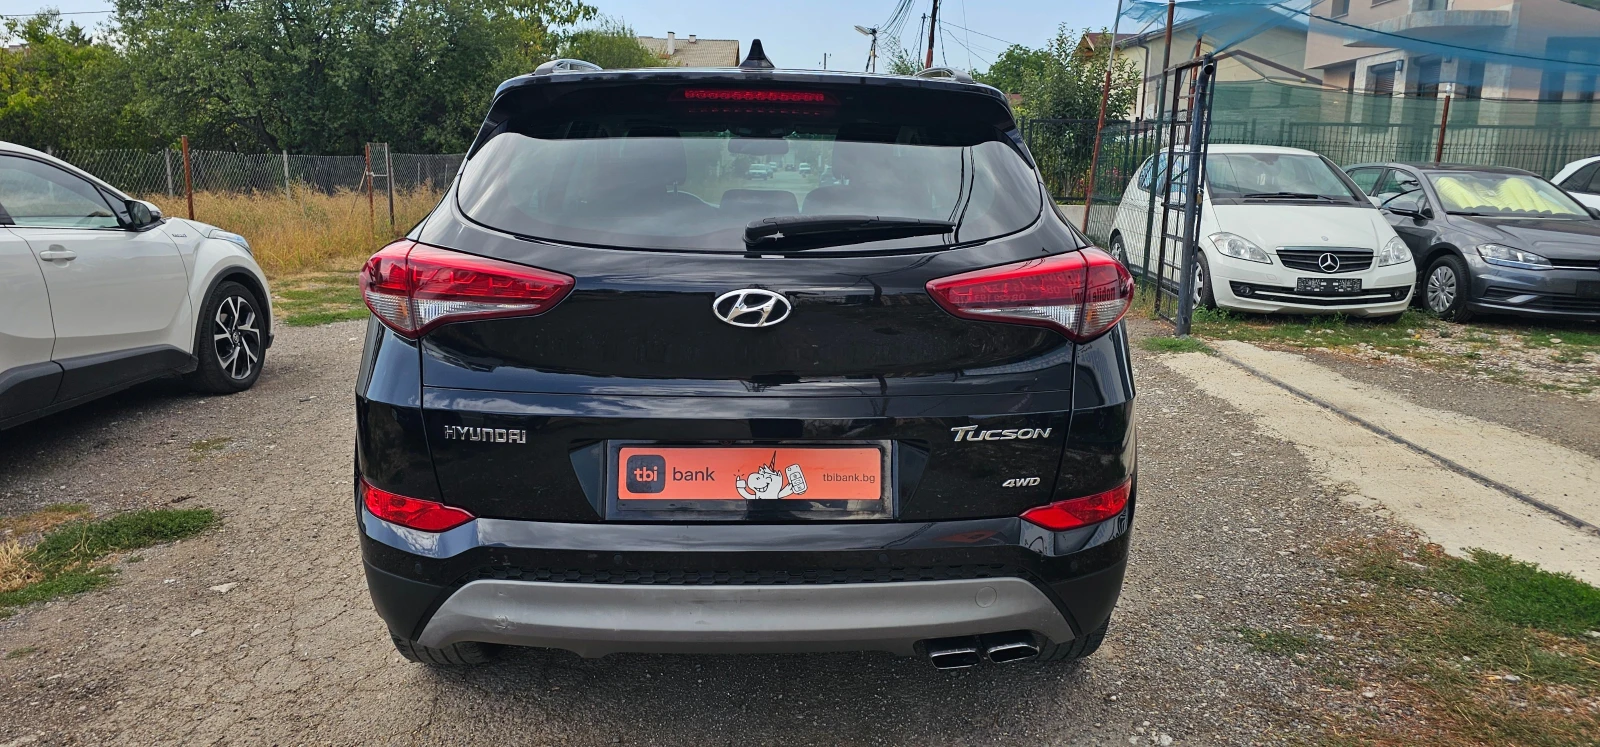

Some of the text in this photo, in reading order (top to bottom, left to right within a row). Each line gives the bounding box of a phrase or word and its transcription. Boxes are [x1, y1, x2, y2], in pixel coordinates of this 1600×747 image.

[444, 425, 526, 444] HYUNDAI
[633, 466, 715, 482] tbi bank
[822, 473, 876, 484] tbibank.bg
[1002, 477, 1041, 488] 4WD
